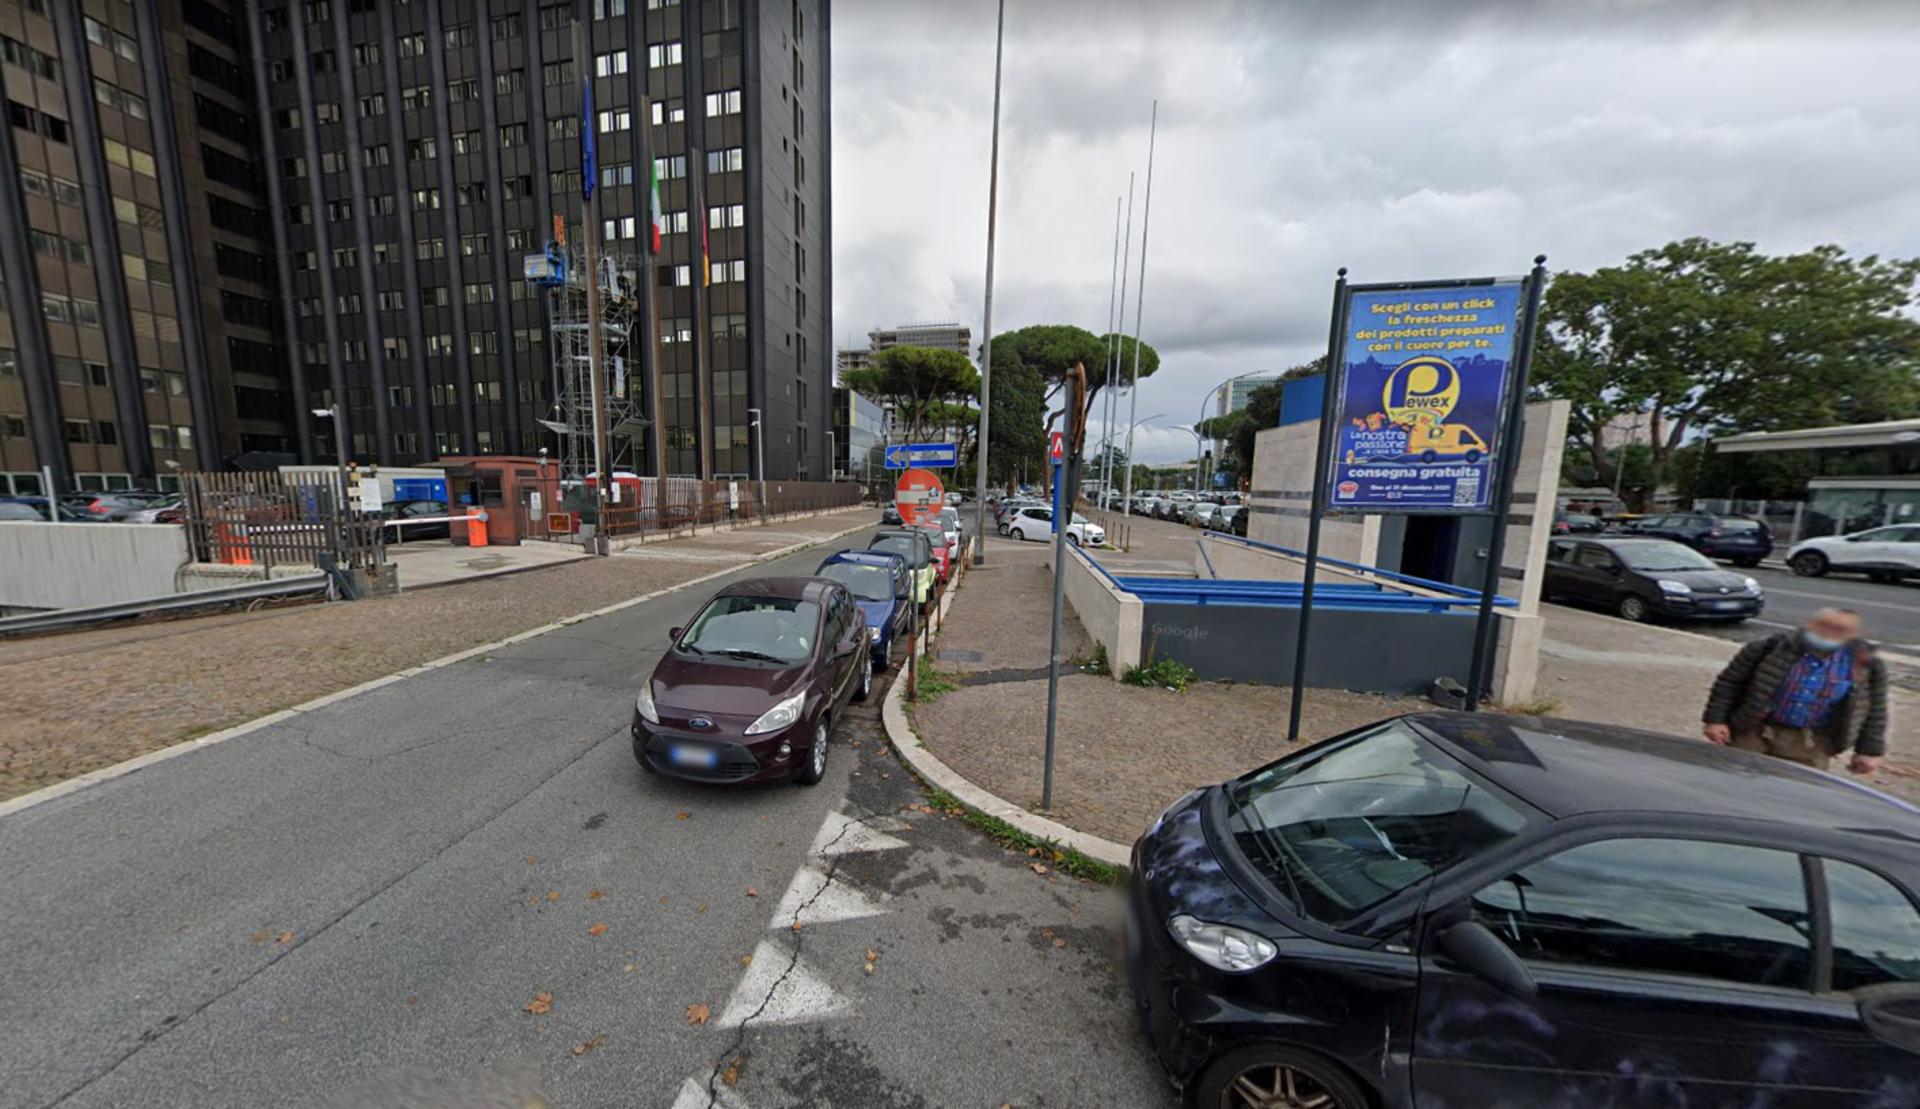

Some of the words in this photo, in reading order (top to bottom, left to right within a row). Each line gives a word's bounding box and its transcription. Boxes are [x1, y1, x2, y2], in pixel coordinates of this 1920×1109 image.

[1371, 302, 1410, 314] Scegli
[1414, 303, 1439, 311] con
[1442, 302, 1459, 310] un
[1463, 298, 1495, 309] click
[1388, 315, 1400, 325] la
[1404, 314, 1477, 324] freschezza
[1355, 330, 1376, 339] dei
[1379, 328, 1437, 340] prodotti
[1440, 324, 1505, 337] preparati
[1368, 343, 1391, 351] con
[1394, 341, 1403, 350] il
[1406, 341, 1444, 350] cuore
[1448, 340, 1470, 351] per
[1390, 361, 1452, 408] Pewex
[1361, 430, 1406, 442] nostra
[1354, 440, 1406, 451] passione
[1348, 469, 1417, 480] consegna
[1419, 466, 1480, 480] gratuita
